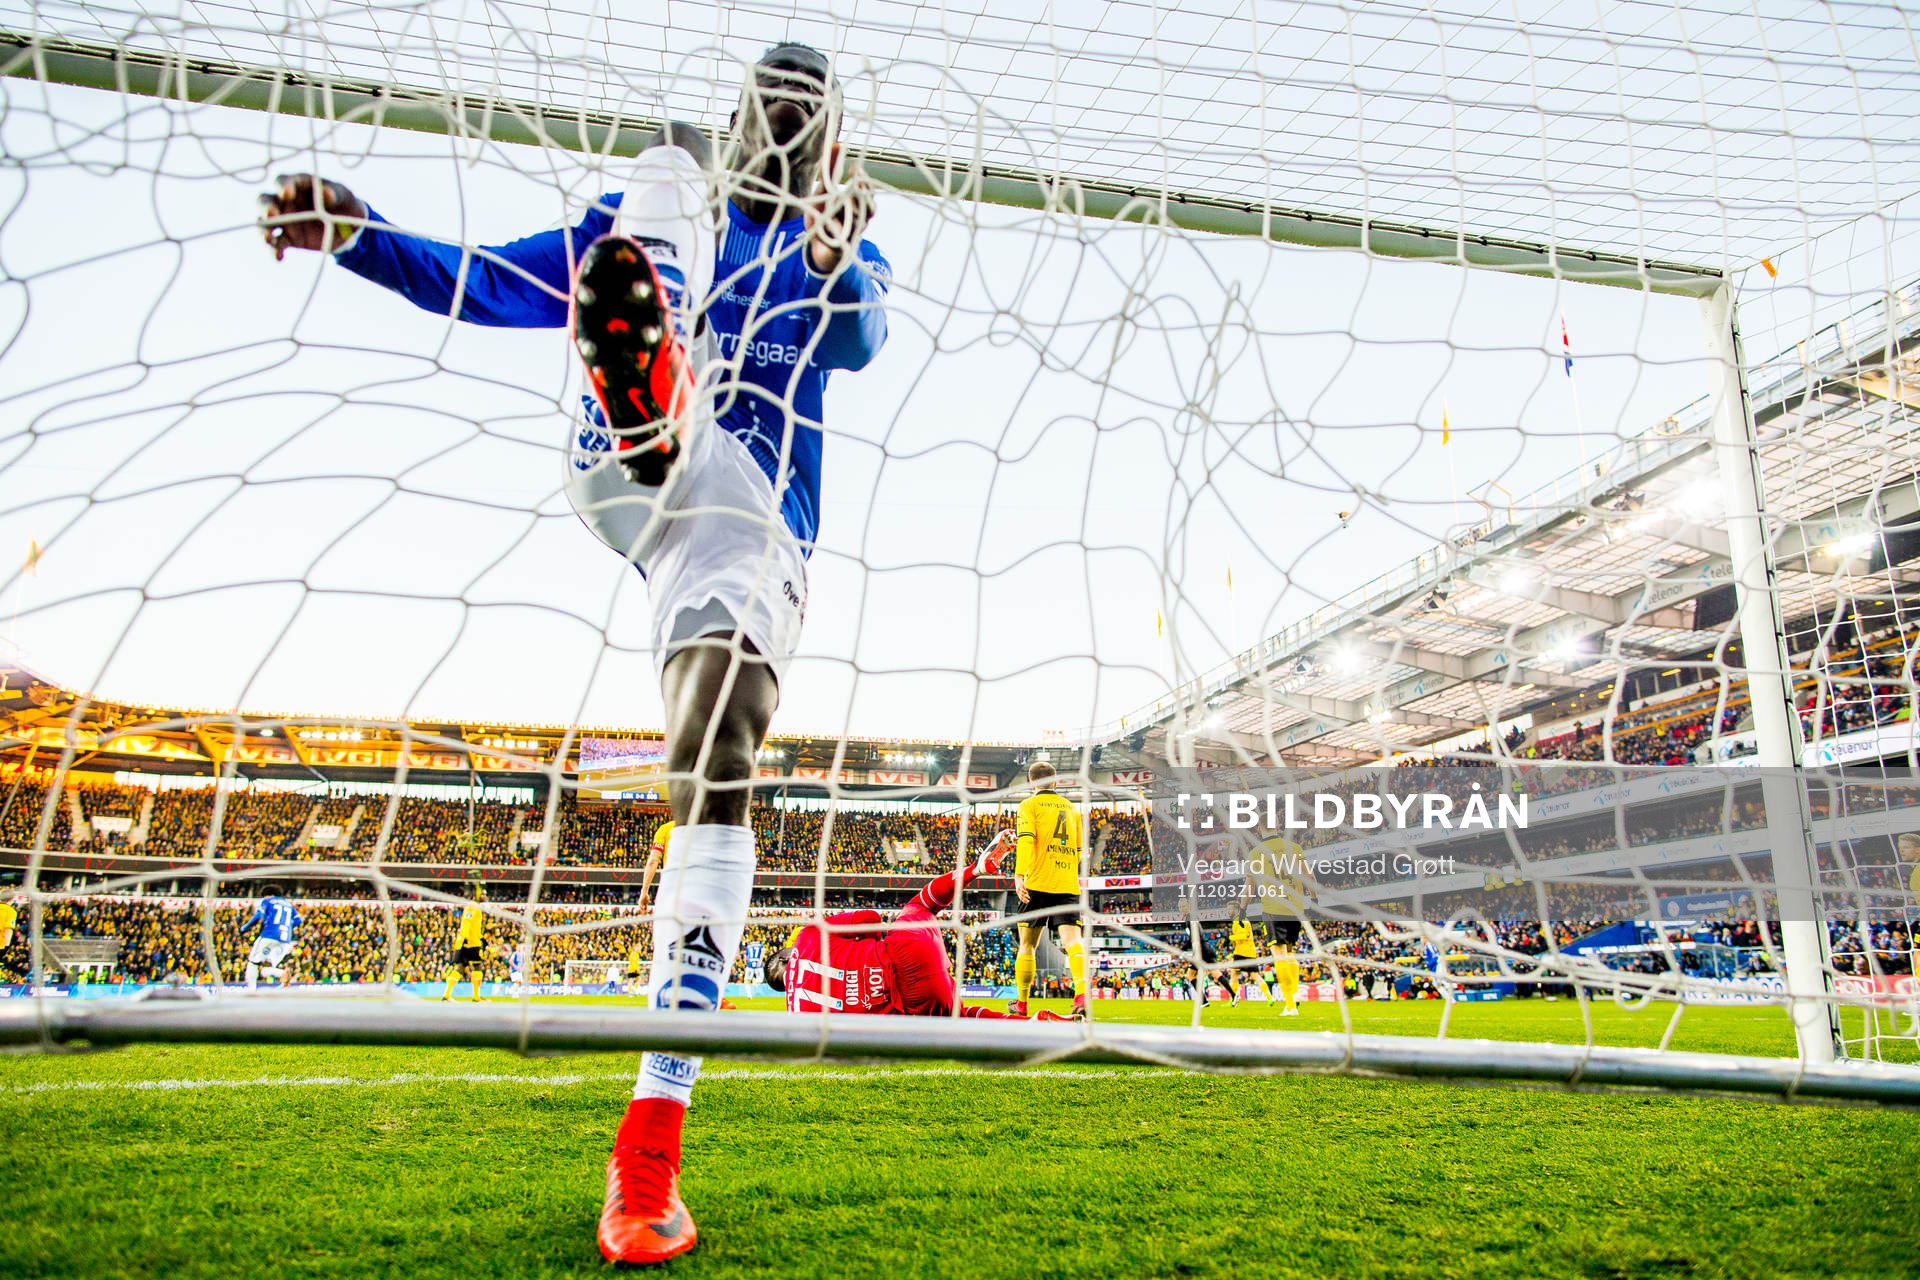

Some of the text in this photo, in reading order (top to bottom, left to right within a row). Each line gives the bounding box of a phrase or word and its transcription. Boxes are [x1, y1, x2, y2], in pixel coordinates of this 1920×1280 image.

[319, 750, 376, 764] VG
[875, 769, 925, 785] VG
[1112, 771, 1158, 785] VG
[1053, 810, 1069, 840] 4
[845, 969, 859, 1006] ORIGI
